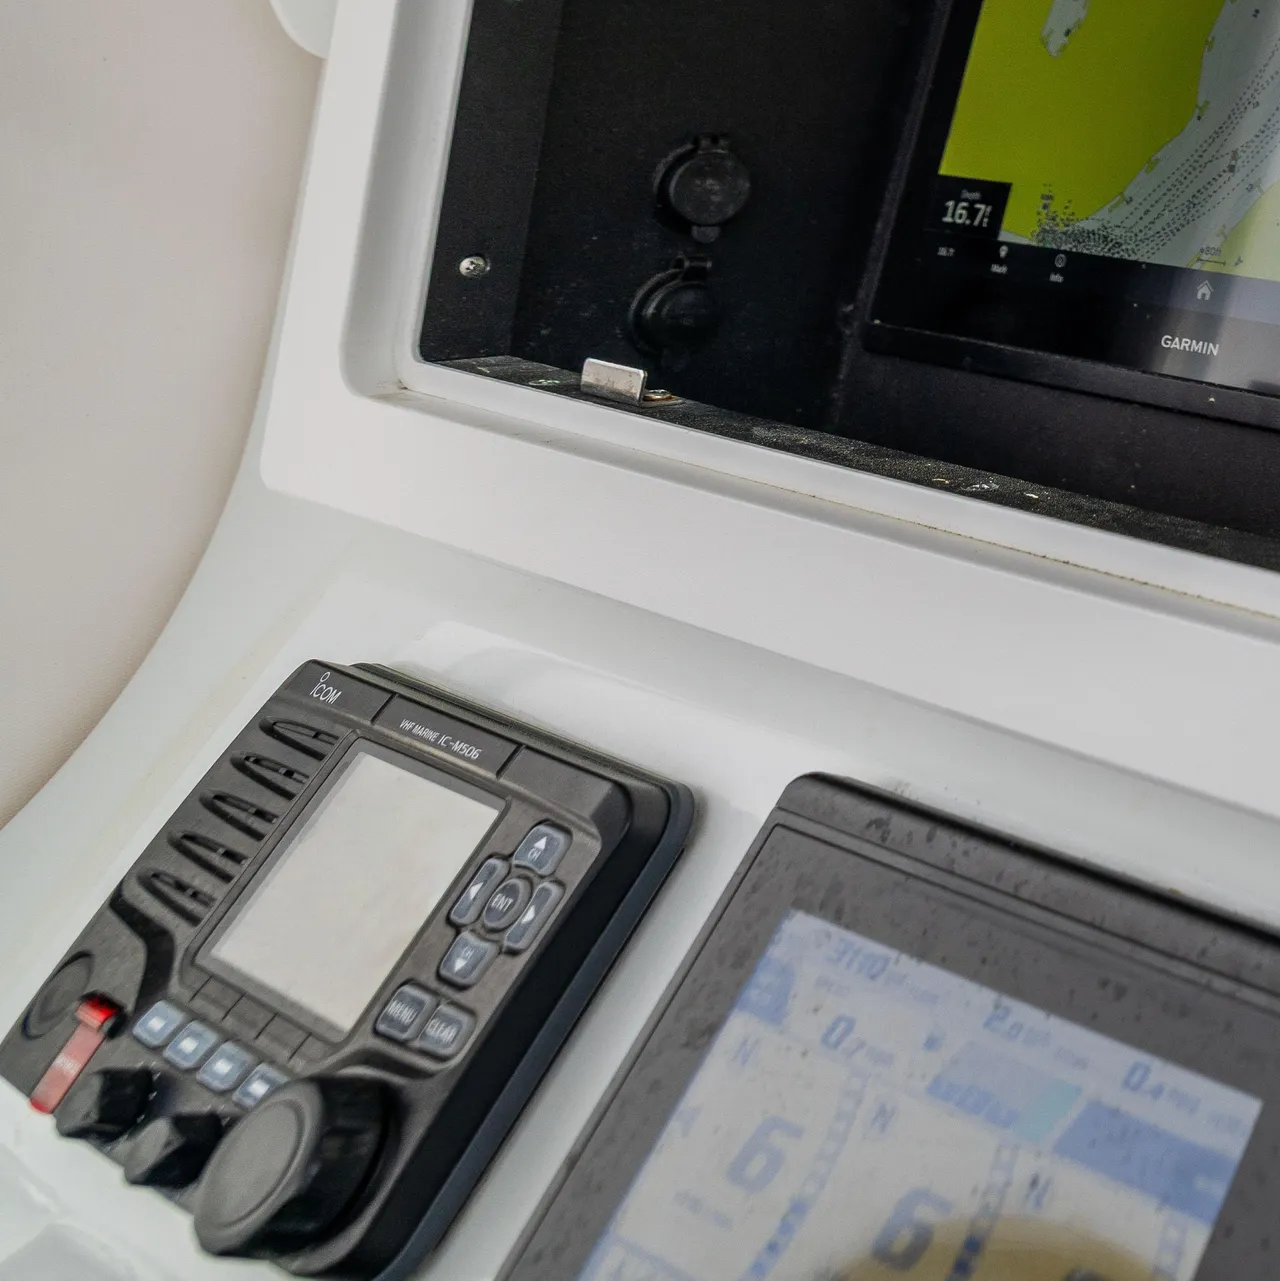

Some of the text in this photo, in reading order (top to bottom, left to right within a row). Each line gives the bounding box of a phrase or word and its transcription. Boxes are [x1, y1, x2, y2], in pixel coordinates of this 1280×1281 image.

[1161, 334, 1220, 356] GARMIN
[399, 718, 483, 760] VHF MARINE IC-M506
[492, 894, 514, 911] ENT
[387, 1001, 417, 1024] MENU
